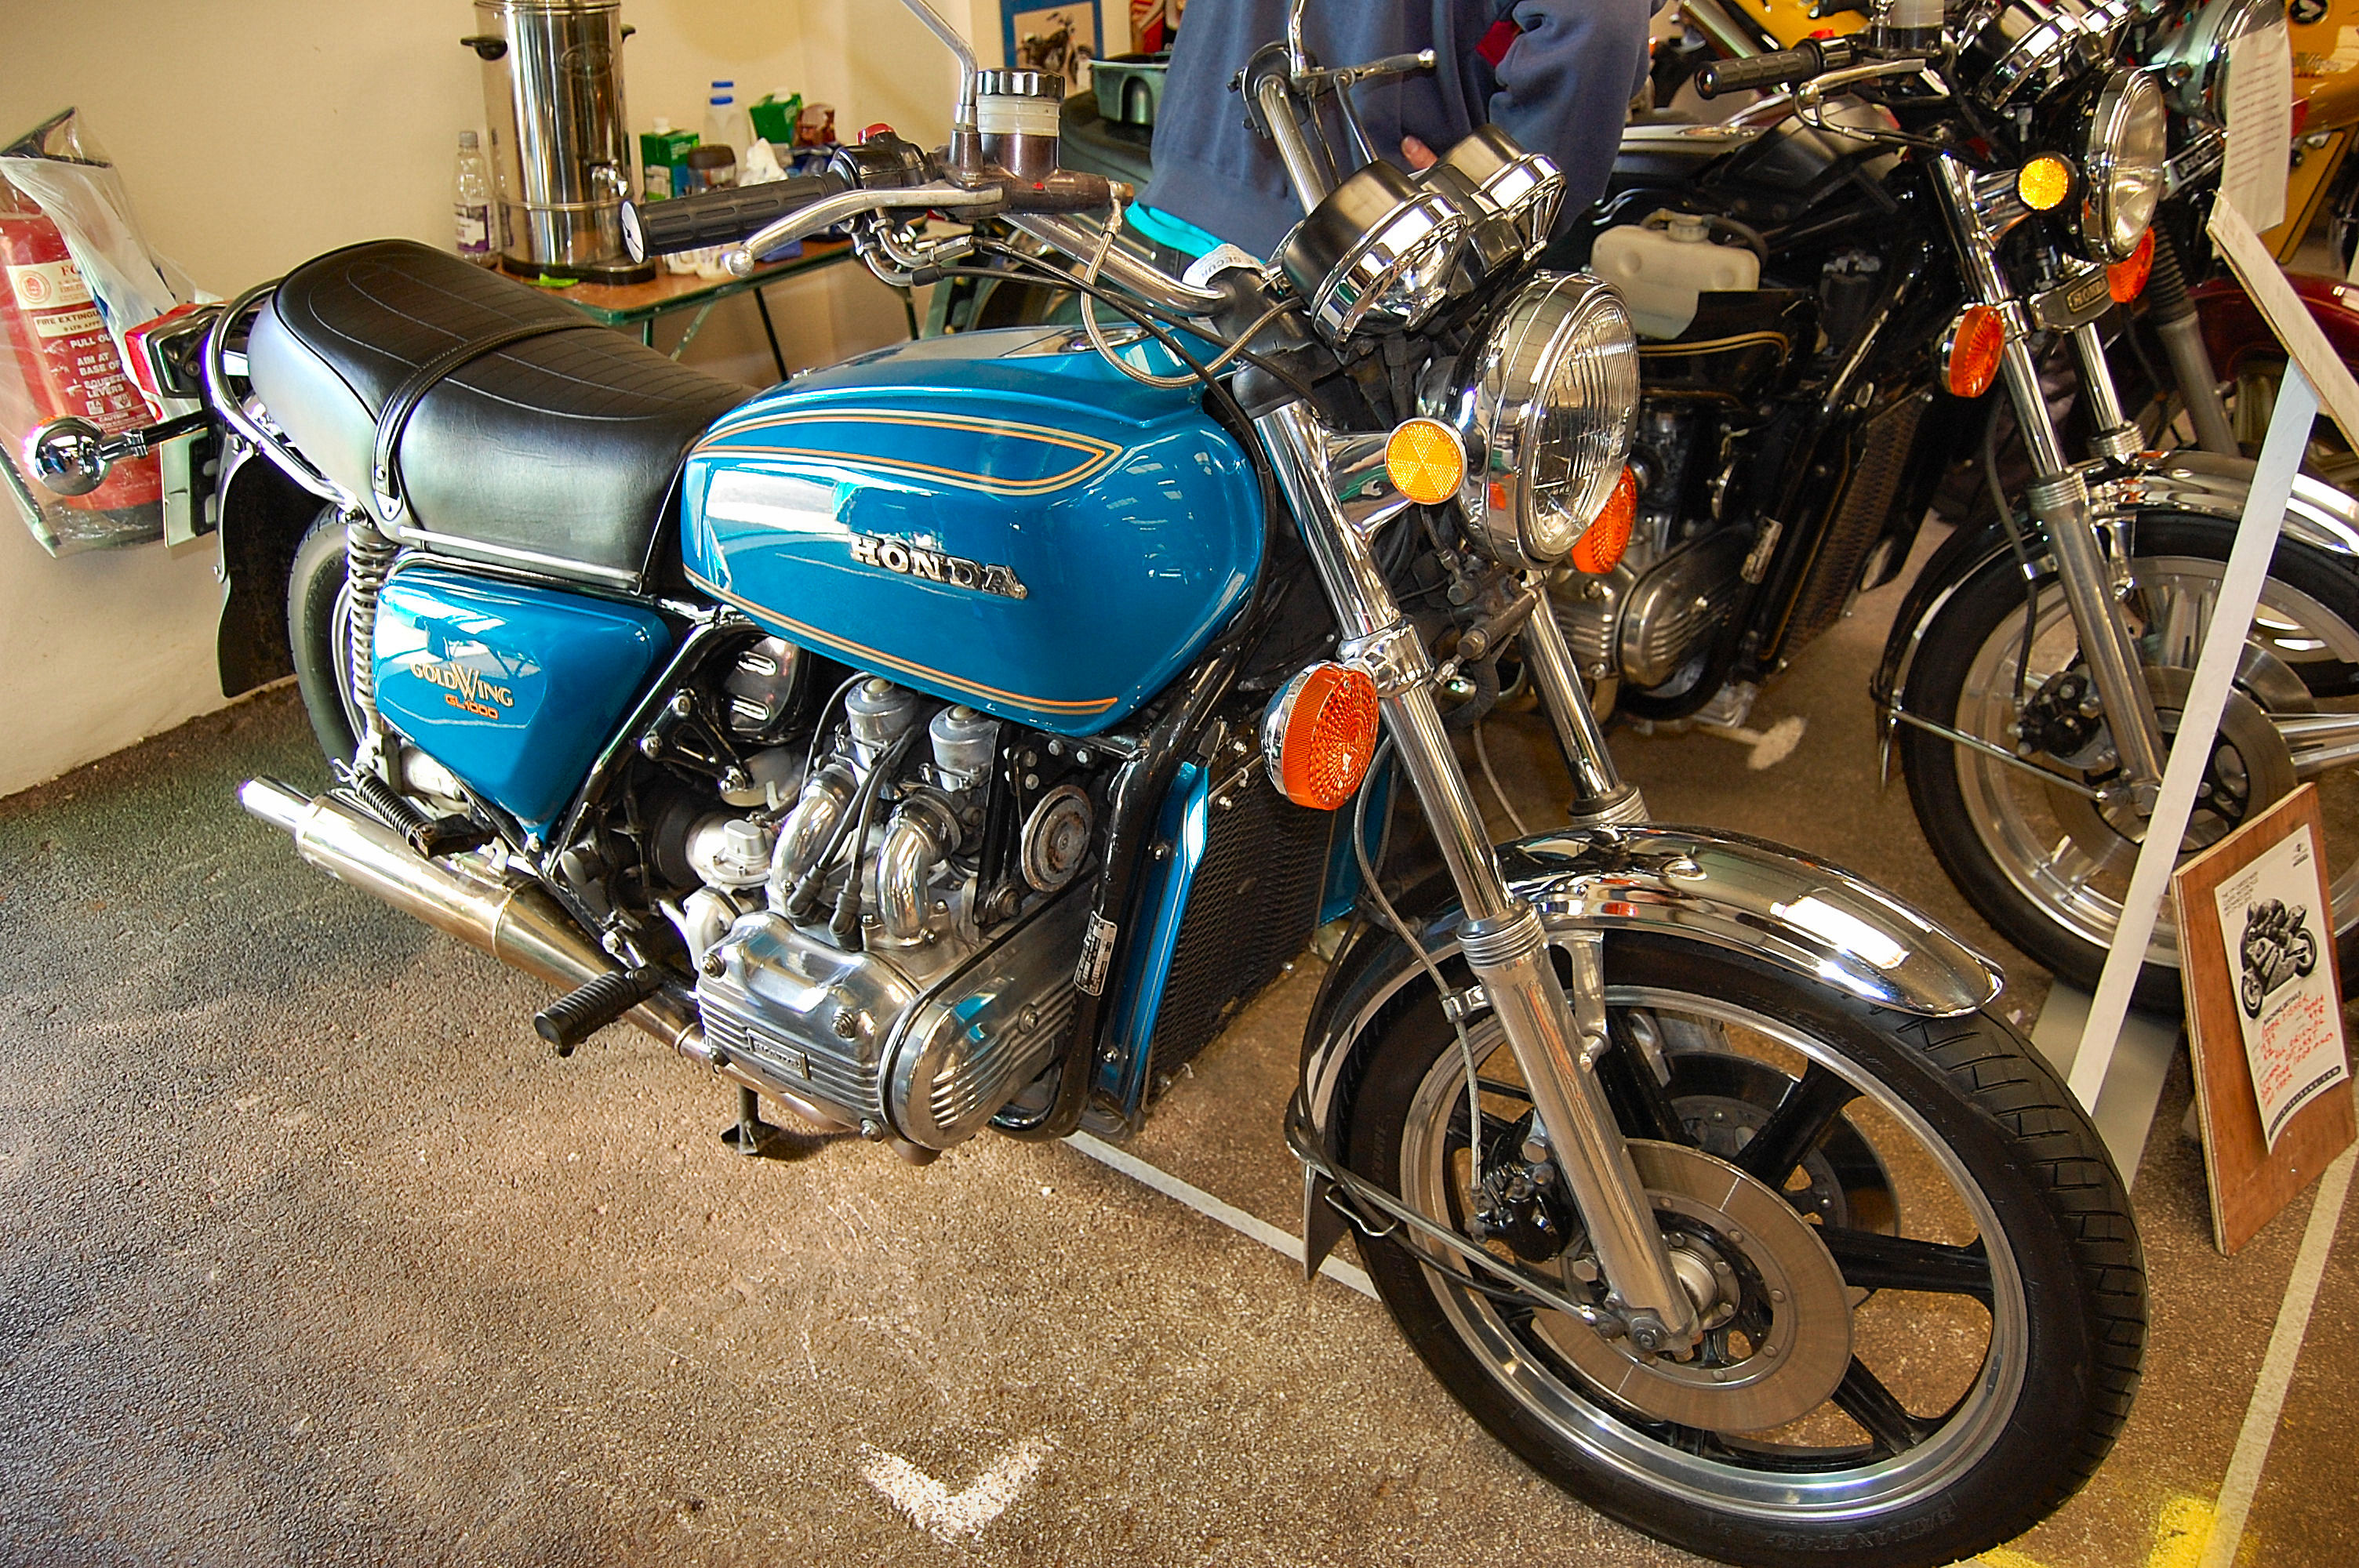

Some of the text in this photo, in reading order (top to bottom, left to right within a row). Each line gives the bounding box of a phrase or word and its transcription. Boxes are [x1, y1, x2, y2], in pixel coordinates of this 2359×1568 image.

[58, 310, 99, 324] EXTINGU
[70, 333, 111, 349] PULL OU
[77, 352, 110, 366] AIM AT
[78, 363, 107, 376] BASE
[86, 383, 125, 399] LEVERS
[849, 532, 1027, 600] HONDA
[444, 694, 500, 720] GL1000
